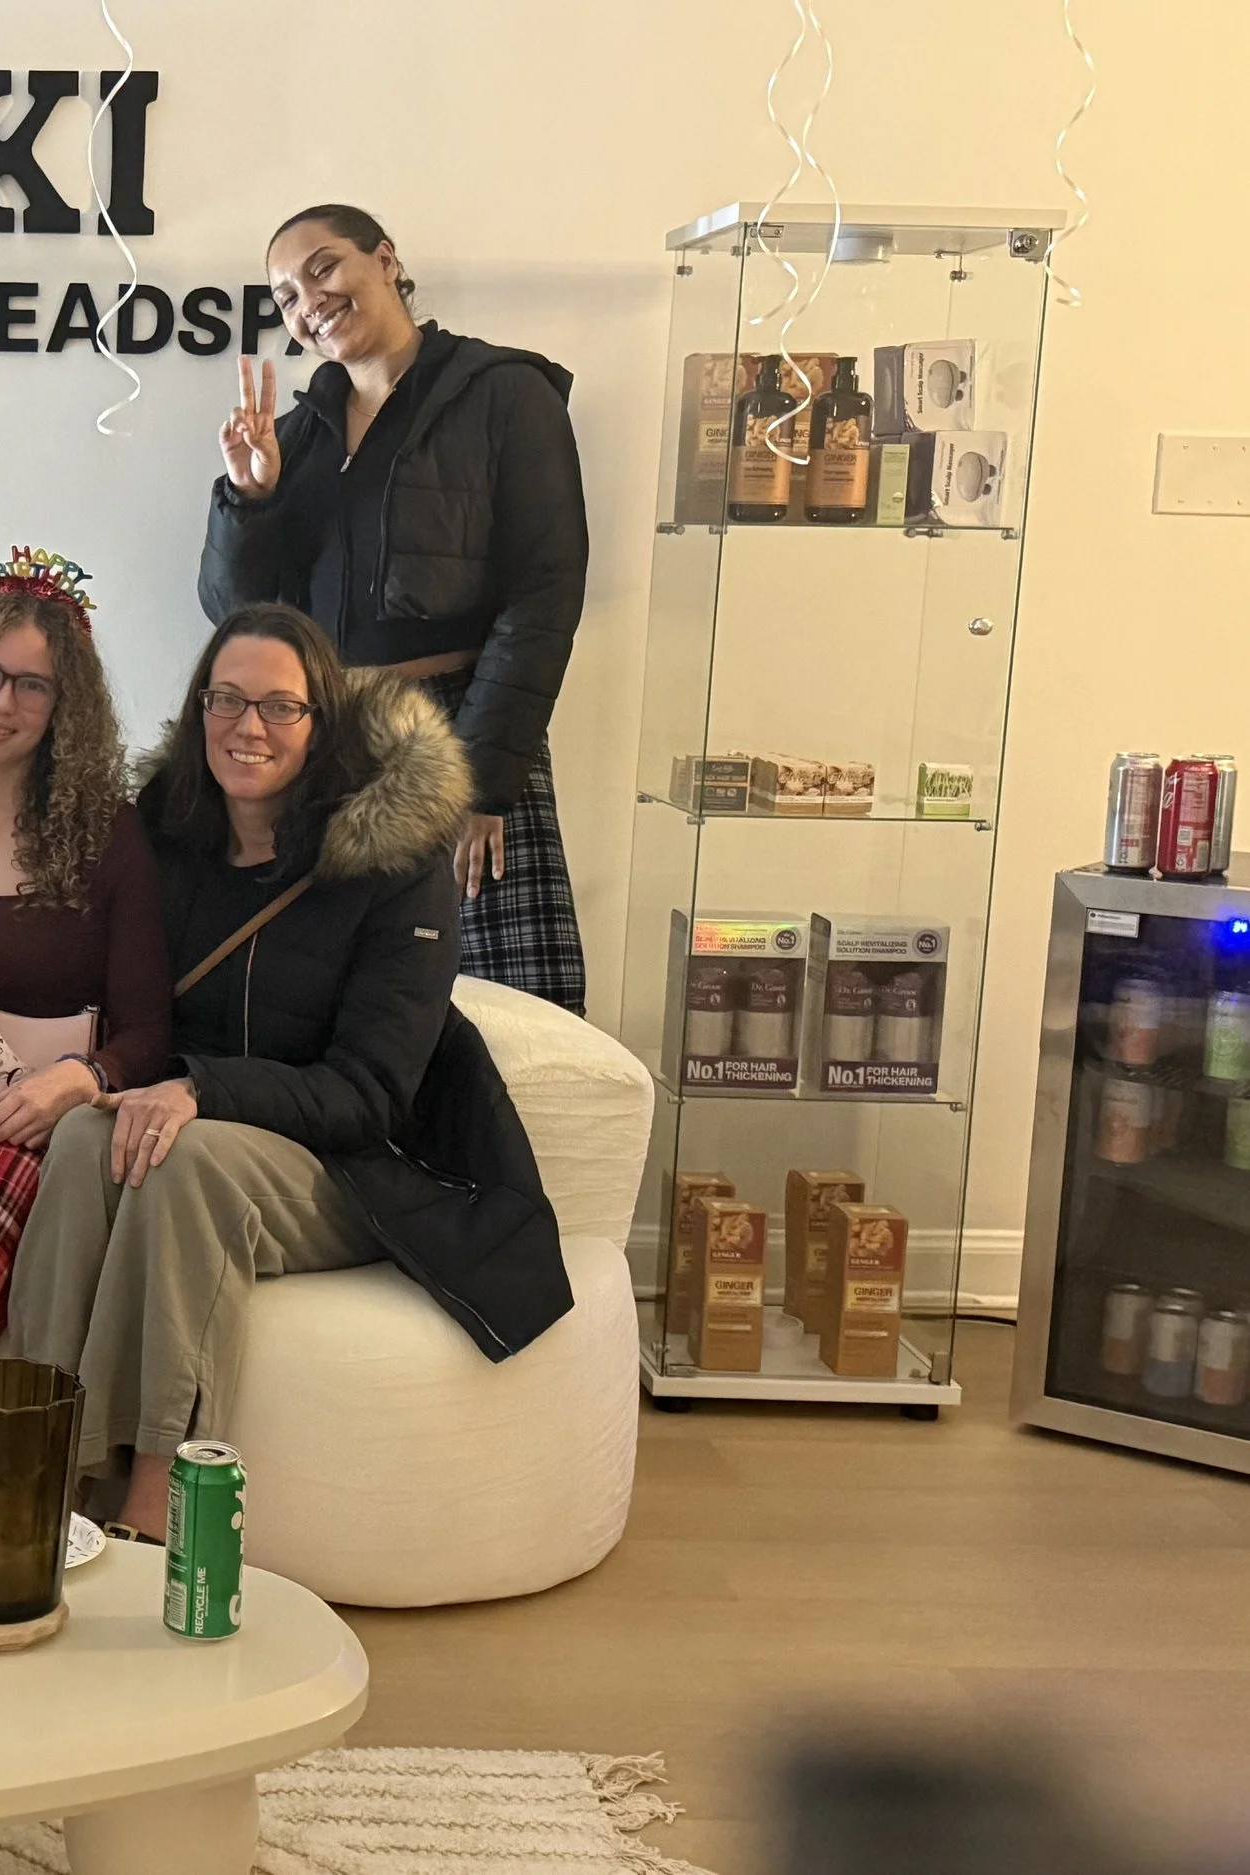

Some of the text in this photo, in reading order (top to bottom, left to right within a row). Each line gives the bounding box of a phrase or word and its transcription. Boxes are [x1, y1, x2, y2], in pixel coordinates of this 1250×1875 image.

[11, 545, 94, 585] HAPPY
[860, 940, 907, 948] REVITALIZING
[687, 1060, 724, 1080] No.1
[725, 1062, 777, 1072] FOR HAIR
[866, 1066, 918, 1077] FOR HAIR
[725, 1071, 793, 1082] THICKENING
[828, 1065, 865, 1086] No.1
[866, 1075, 933, 1087] THICKENING
[715, 1281, 754, 1290] GINGER
[853, 1287, 893, 1297] GINGER
[196, 1566, 207, 1585] ME
[194, 1586, 206, 1635] RECYCLE
